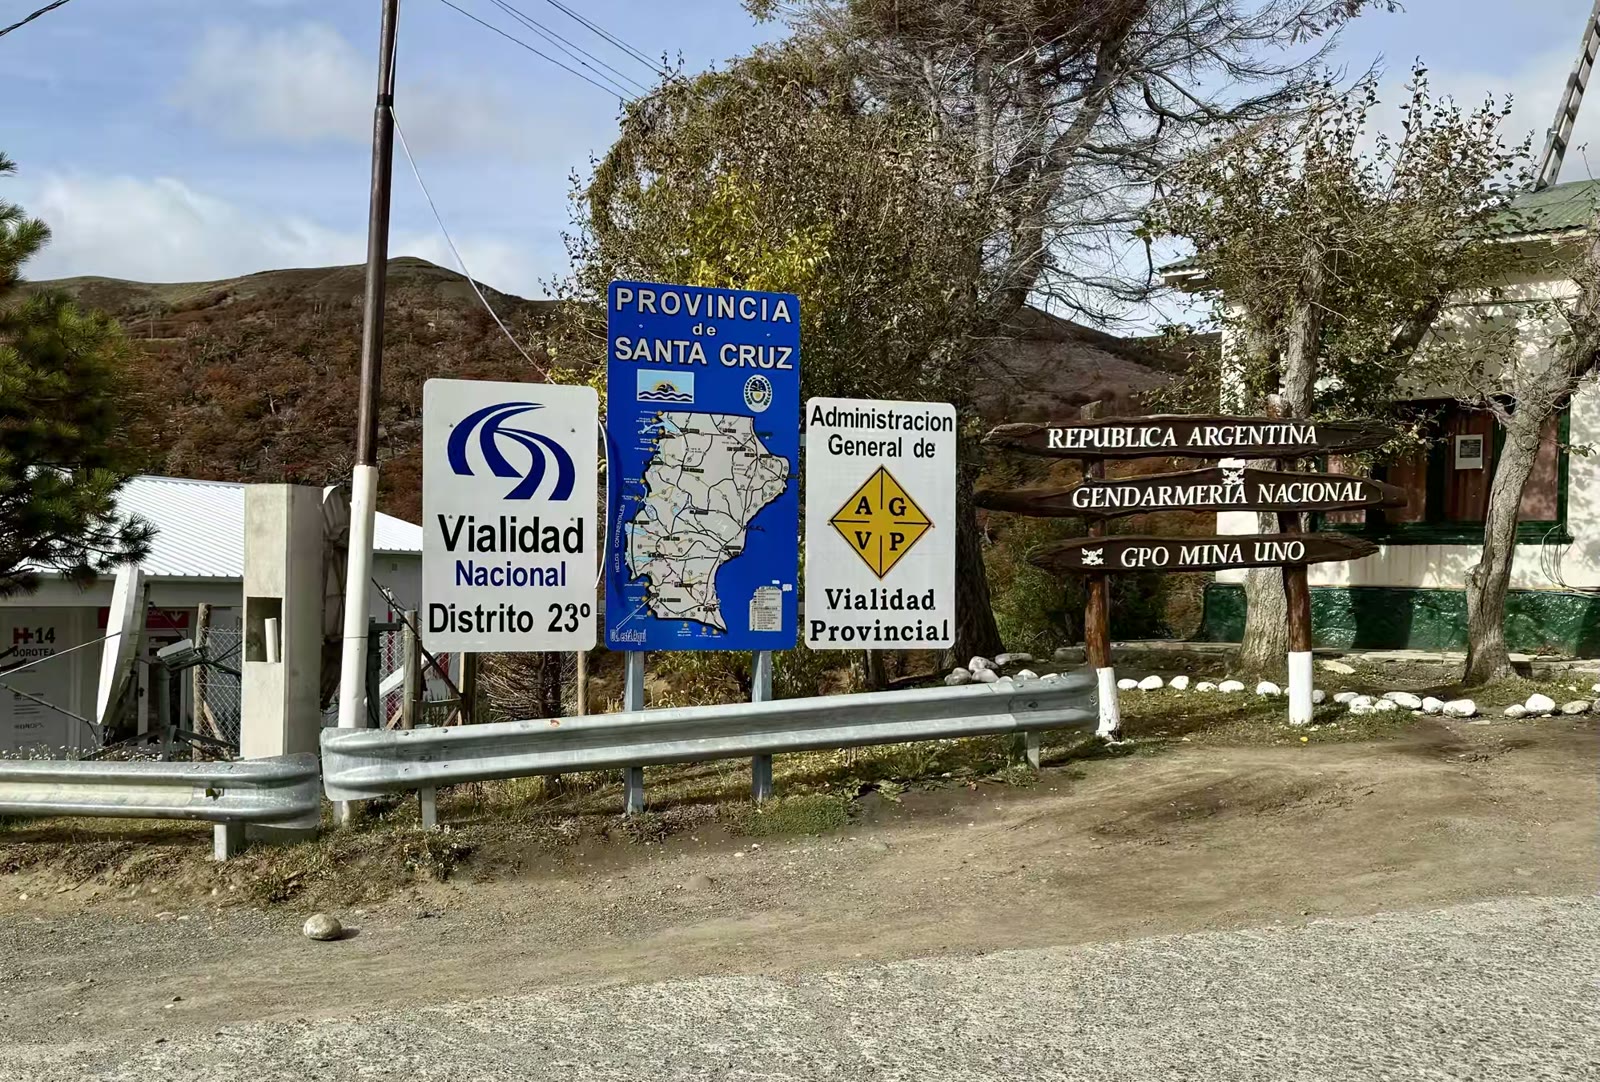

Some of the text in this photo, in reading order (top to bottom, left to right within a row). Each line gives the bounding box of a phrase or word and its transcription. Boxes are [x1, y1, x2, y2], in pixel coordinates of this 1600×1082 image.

[616, 288, 792, 323] PROVINCIA
[692, 323, 717, 336] de
[615, 337, 793, 370] SANTA CRUZ
[810, 405, 953, 432] Administracion
[828, 434, 936, 458] General de
[1047, 425, 1318, 448] REPUBLICA ARGENTINA
[1257, 482, 1367, 503] NACIONAL
[855, 496, 906, 516] A G
[437, 514, 584, 554] Vialidad
[855, 531, 905, 551] V P
[1120, 541, 1305, 568] GPO MINA UNO
[455, 560, 566, 587] Nacional
[825, 588, 935, 610] Vialidad
[428, 603, 534, 633] Distrito
[810, 619, 950, 642] Provincial
